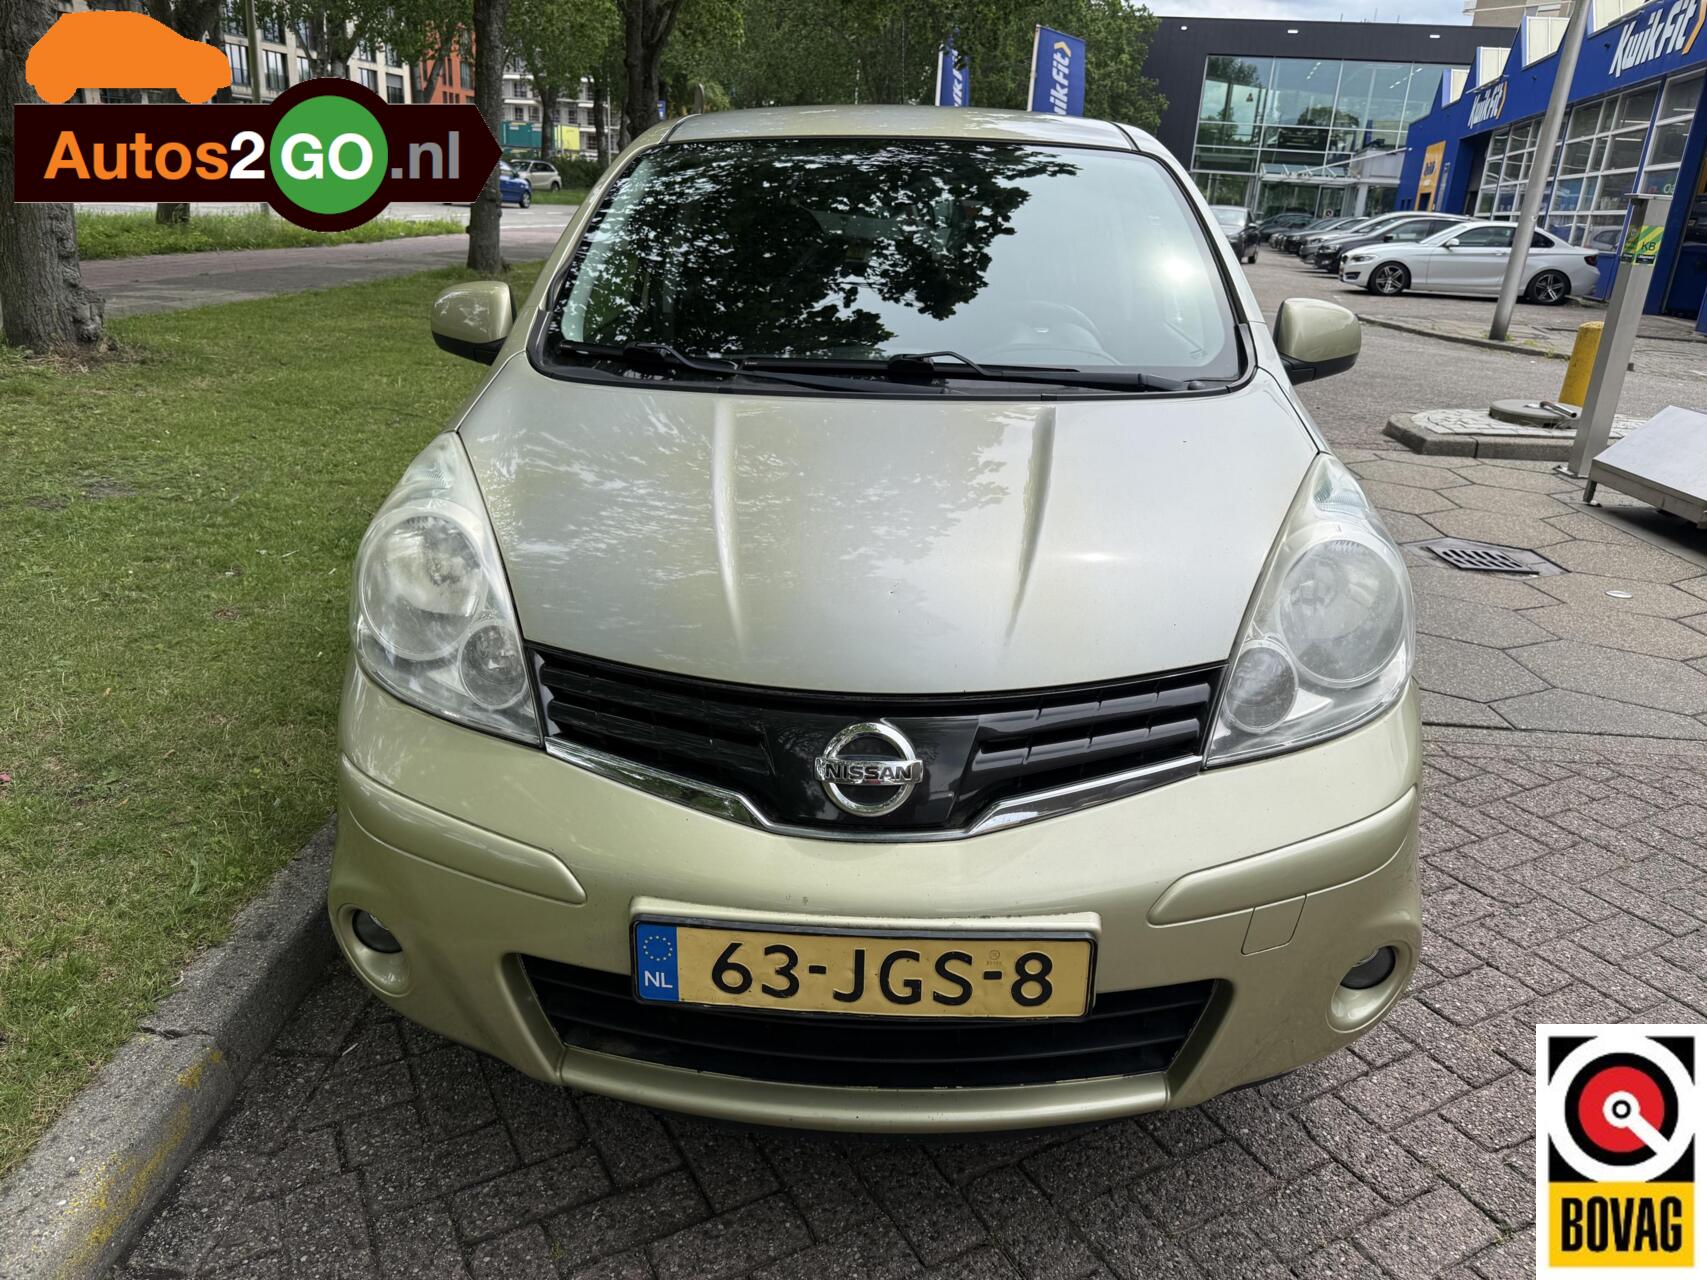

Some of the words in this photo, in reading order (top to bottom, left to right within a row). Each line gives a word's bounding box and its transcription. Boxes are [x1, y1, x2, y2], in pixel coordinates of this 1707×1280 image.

[1608, 0, 1697, 77] KwikFit
[825, 762, 913, 780] NISSAN
[643, 970, 673, 989] NL
[710, 942, 1053, 1006] 63-JGS-8
